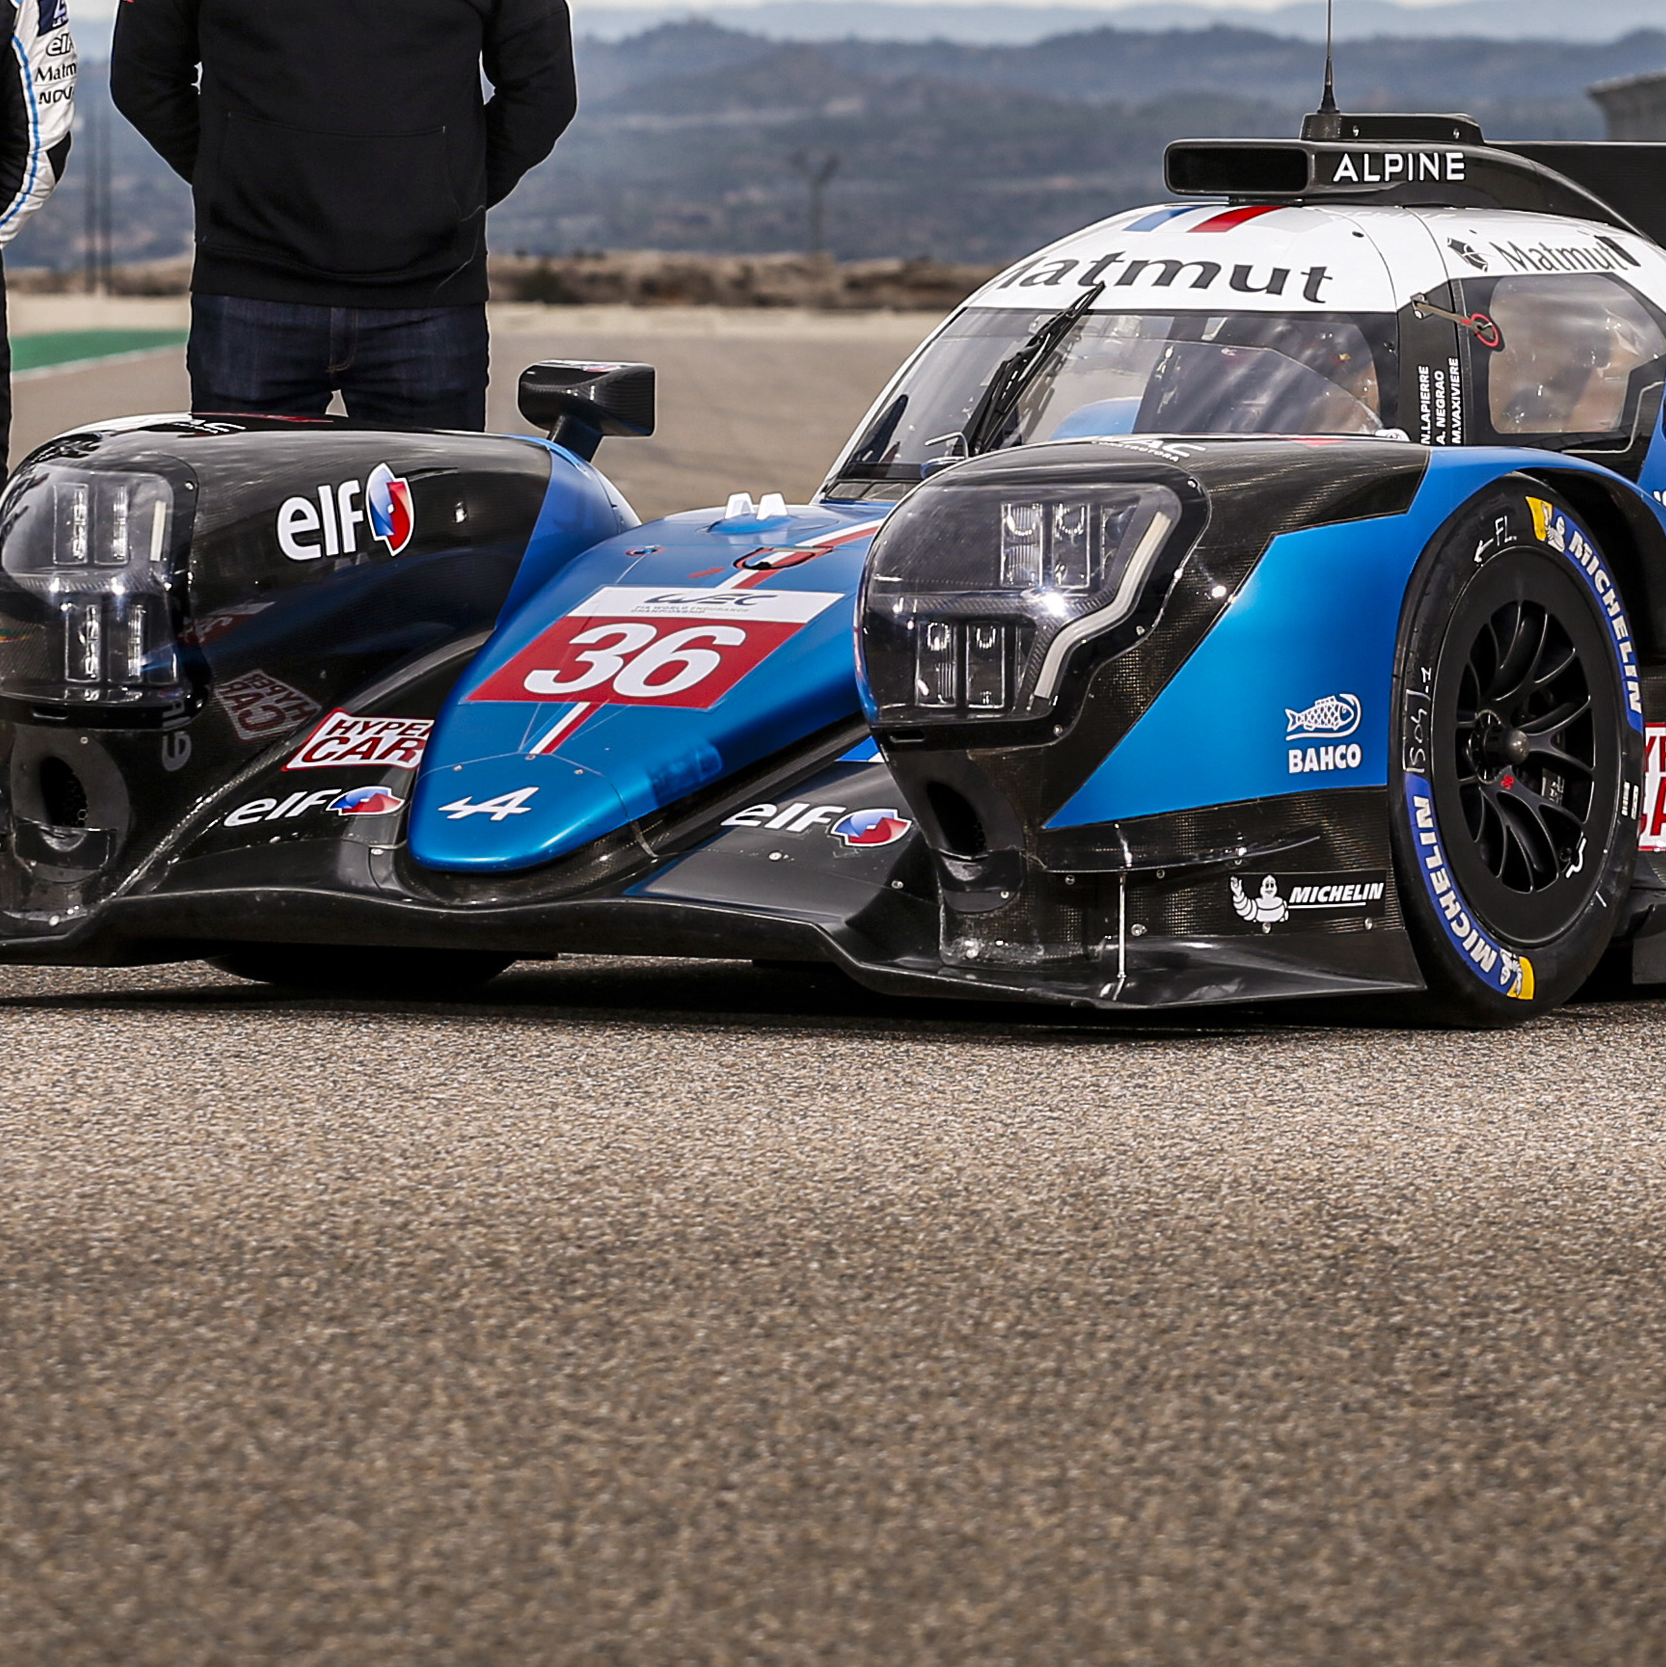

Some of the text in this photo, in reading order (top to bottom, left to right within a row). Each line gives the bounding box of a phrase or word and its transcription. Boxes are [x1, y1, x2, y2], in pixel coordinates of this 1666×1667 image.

[1332, 151, 1466, 183] ALPINE
[1489, 240, 1625, 272] Matmut
[1434, 370, 1446, 428] NEGRAO
[276, 479, 364, 562] elf
[643, 593, 778, 606] WEC
[1568, 531, 1643, 714] MICHELIN
[523, 622, 748, 699] 36
[325, 719, 433, 736] HYPE
[1288, 742, 1362, 775] BAHCO
[223, 787, 343, 829] elf
[720, 802, 848, 833] elf
[1289, 882, 1384, 904] MICHELIN
[1412, 794, 1504, 974] MICHELIN
